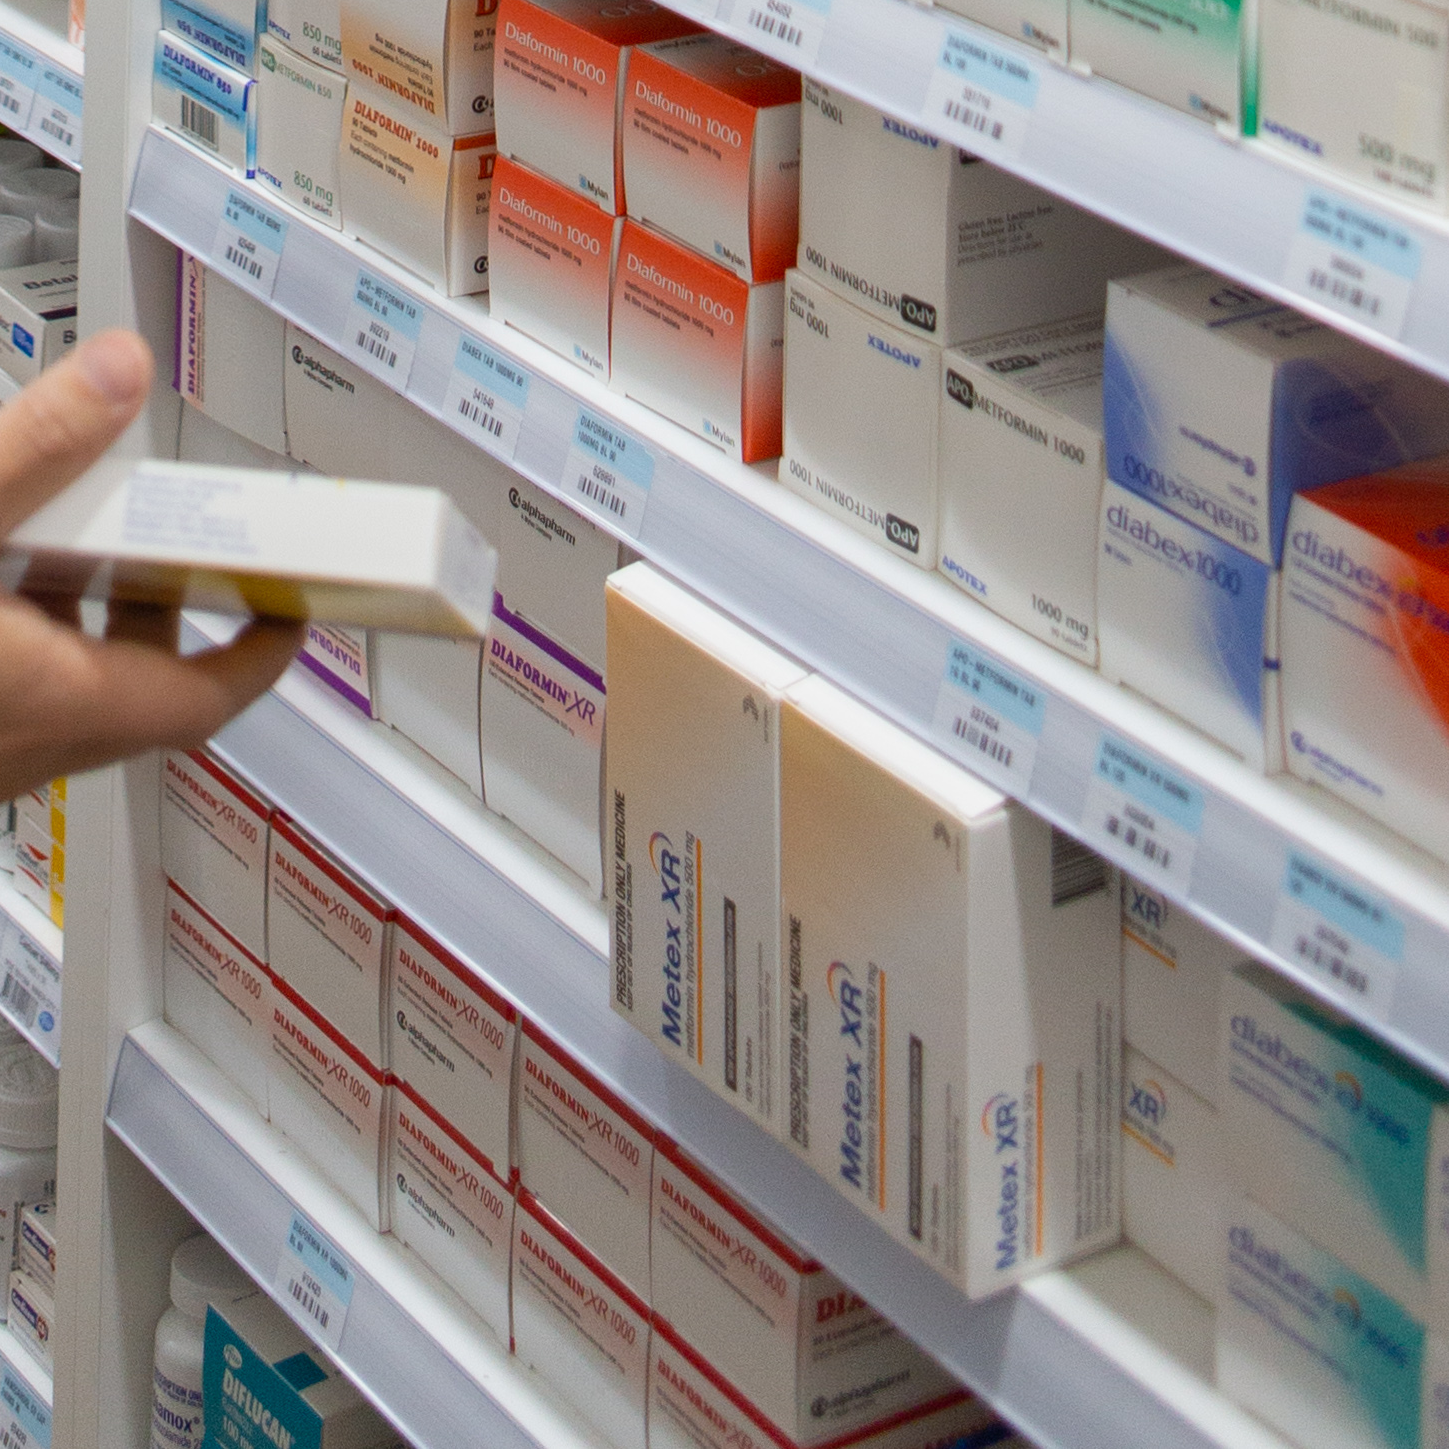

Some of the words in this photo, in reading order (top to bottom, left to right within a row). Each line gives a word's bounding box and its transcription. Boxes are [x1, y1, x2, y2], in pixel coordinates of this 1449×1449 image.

[302, 21, 322, 44] 850
[323, 33, 342, 56] mg
[505, 20, 569, 67] Diaformin
[573, 56, 606, 86] 1000
[354, 100, 413, 142] DIAFORMIN
[416, 134, 439, 159] 1000
[635, 80, 701, 128] Diaformin
[706, 118, 742, 149] 1000
[882, 116, 938, 149] APOTEX
[587, 180, 609, 200] Mylan
[805, 245, 828, 272] 1000
[712, 424, 735, 447] Mylan
[946, 367, 1049, 449] APO-METFORMIN
[1053, 434, 1084, 465] 1000
[520, 498, 576, 546] alphapharm
[1107, 505, 1241, 596] diabex1000
[941, 555, 987, 596] APOTEX
[491, 638, 570, 703] DIAFORMIN
[566, 690, 596, 726] XR
[660, 846, 681, 914] XR
[329, 899, 349, 927] XR
[350, 916, 372, 945] 1000
[615, 901, 627, 1004] PRESCRIPTION
[662, 917, 681, 1048] Metex
[840, 978, 863, 1050] XR
[588, 1111, 613, 1146] XR
[613, 1130, 640, 1167] 1000
[840, 1054, 863, 1187] Metex
[223, 1368, 293, 1449] DIFLUCAN
